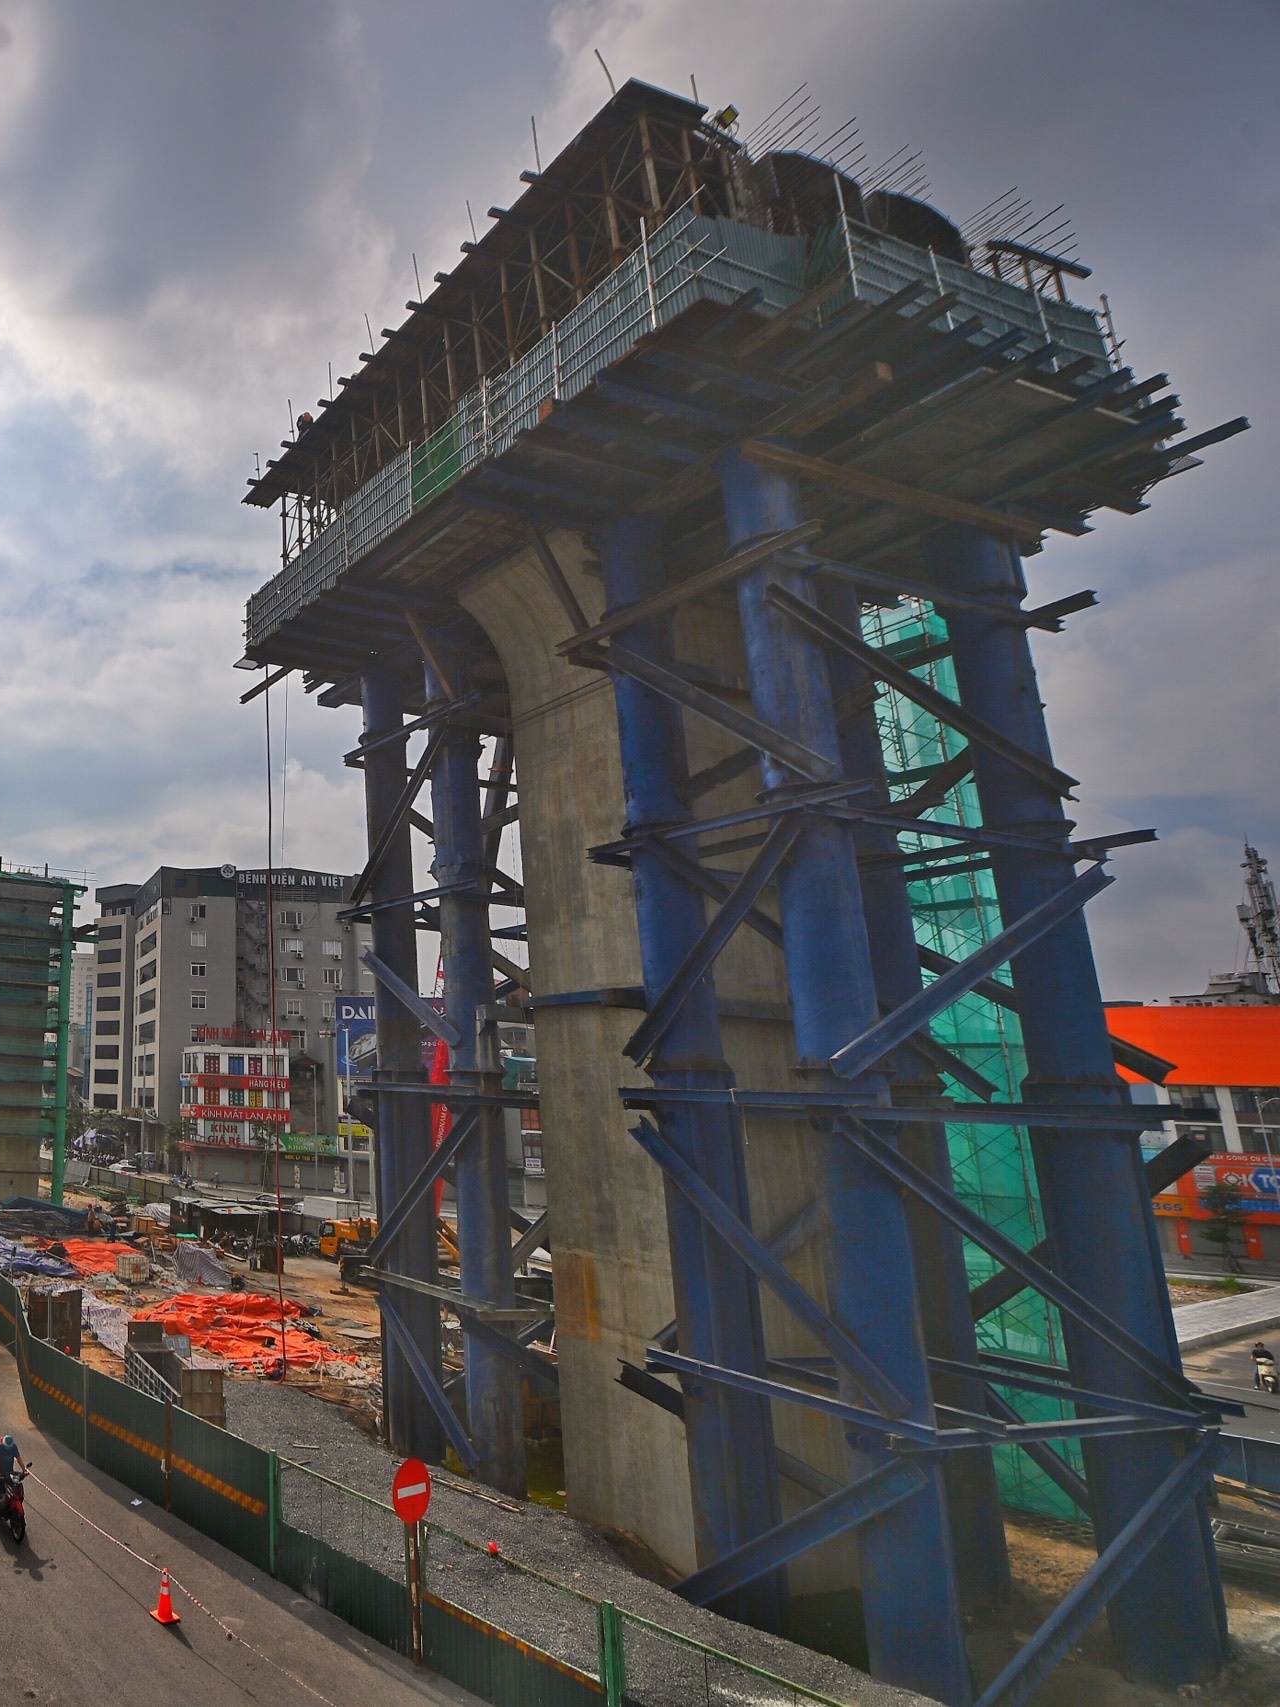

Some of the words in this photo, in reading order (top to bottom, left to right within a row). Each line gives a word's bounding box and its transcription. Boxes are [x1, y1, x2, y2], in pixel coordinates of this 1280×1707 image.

[271, 872, 296, 888] VIỆN
[300, 876, 316, 886] AN
[321, 873, 345, 889] VIỆT
[249, 1078, 269, 1088] HÀNG
[201, 1108, 221, 1118] KÍNH
[223, 1108, 243, 1119] MẮT
[245, 1112, 264, 1120] LAN
[210, 1121, 238, 1134] KÍNH
